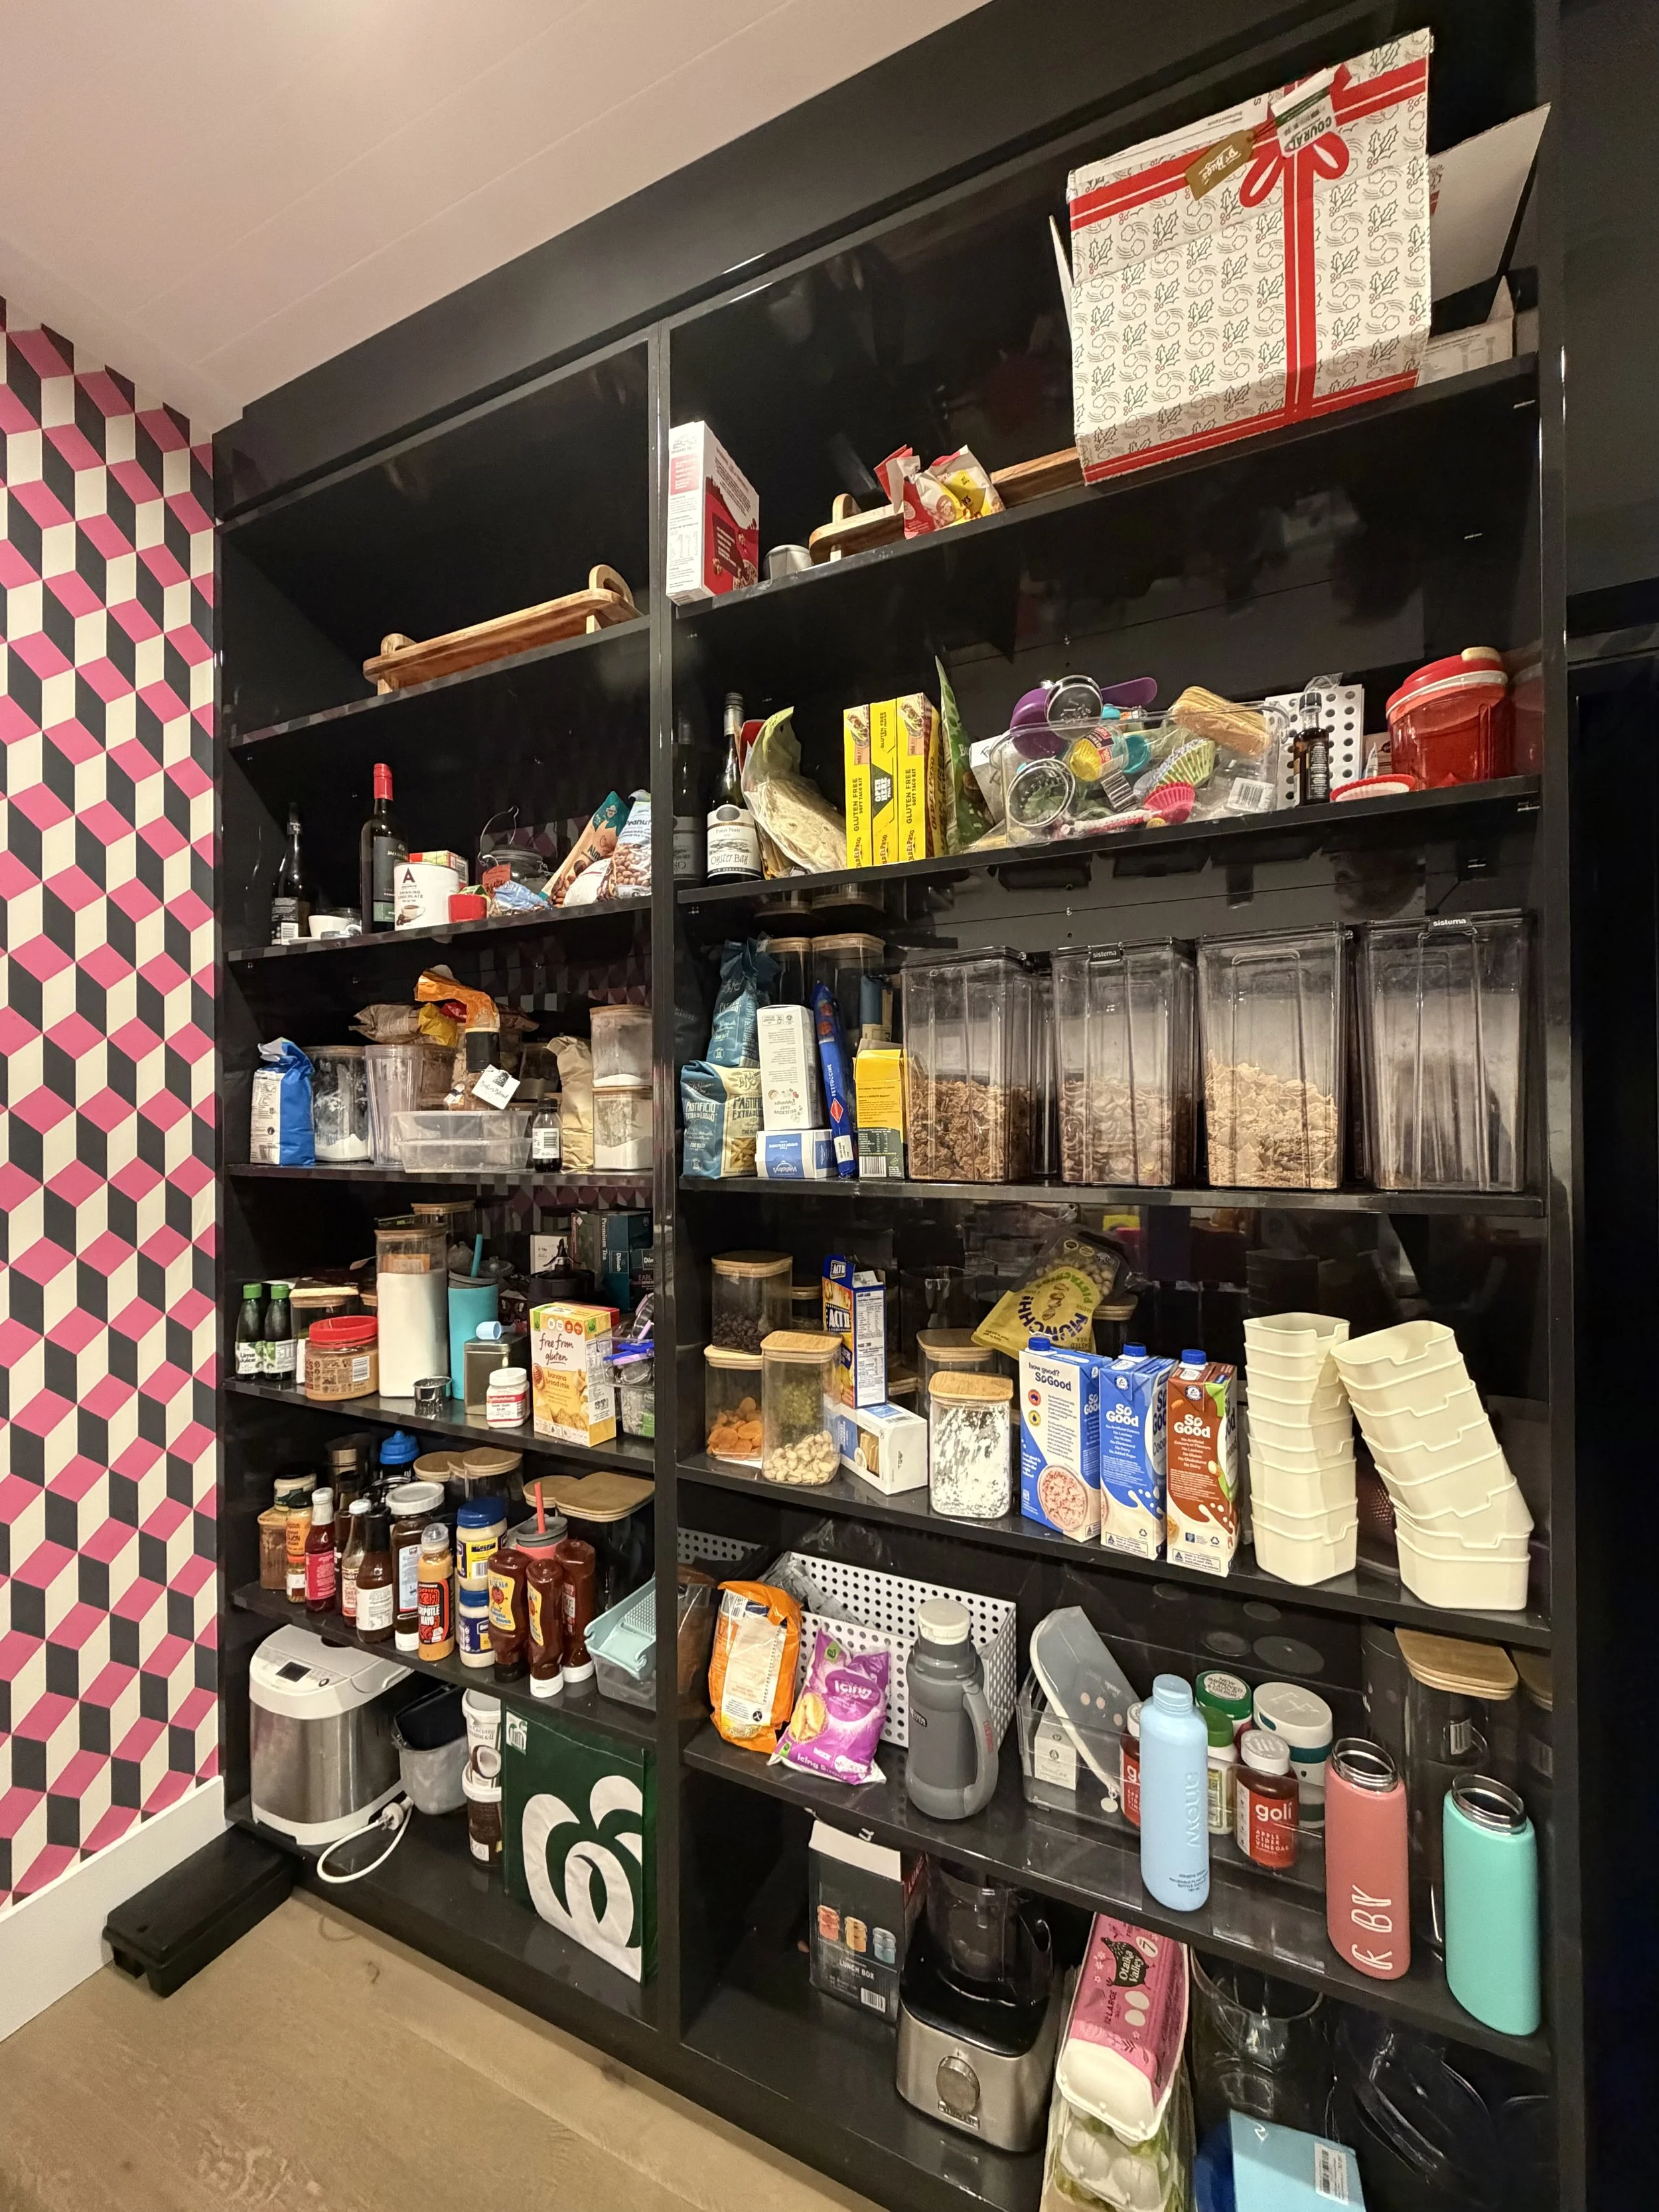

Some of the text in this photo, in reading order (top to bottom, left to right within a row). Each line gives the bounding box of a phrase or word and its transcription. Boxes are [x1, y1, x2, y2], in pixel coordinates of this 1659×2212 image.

[1102, 748, 1110, 762] 100
[711, 853, 733, 866] Oyster
[1433, 918, 1467, 927] sistema
[827, 1064, 836, 1097] FETTUCCINE
[685, 1101, 716, 1113] PASTIFICIO
[700, 1113, 715, 1122] LUSSO
[733, 1109, 752, 1121] EXTRA
[830, 1314, 842, 1328] ACT
[539, 1332, 574, 1352] free from
[545, 1351, 568, 1365] gluten
[547, 1371, 567, 1381] banana
[1029, 1362, 1060, 1377] how good?
[545, 1376, 569, 1389] bread mix
[1088, 1393, 1098, 1405] So
[1116, 1403, 1132, 1416] So
[1106, 1411, 1139, 1427] Good
[1184, 1414, 1203, 1427] So
[1174, 1422, 1210, 1438] Good
[421, 1616, 435, 1625] MAYO
[1207, 1677, 1243, 1693] IMPROVED
[1219, 1676, 1236, 1685] NEW
[834, 1680, 873, 1700] Icing
[797, 1752, 819, 1769] Icing
[1255, 1801, 1293, 1822] goli
[1256, 1829, 1280, 1840] APPLE
[1256, 1835, 1280, 1846] CIDER
[1256, 1840, 1289, 1852] VINEGAR
[1143, 1940, 1156, 1954] 7
[839, 1958, 875, 1980] LUNCH BOX
[1119, 1949, 1134, 1981] Otaika
[1128, 1955, 1144, 1983] Valley
[1105, 1990, 1118, 2017] LARGE
